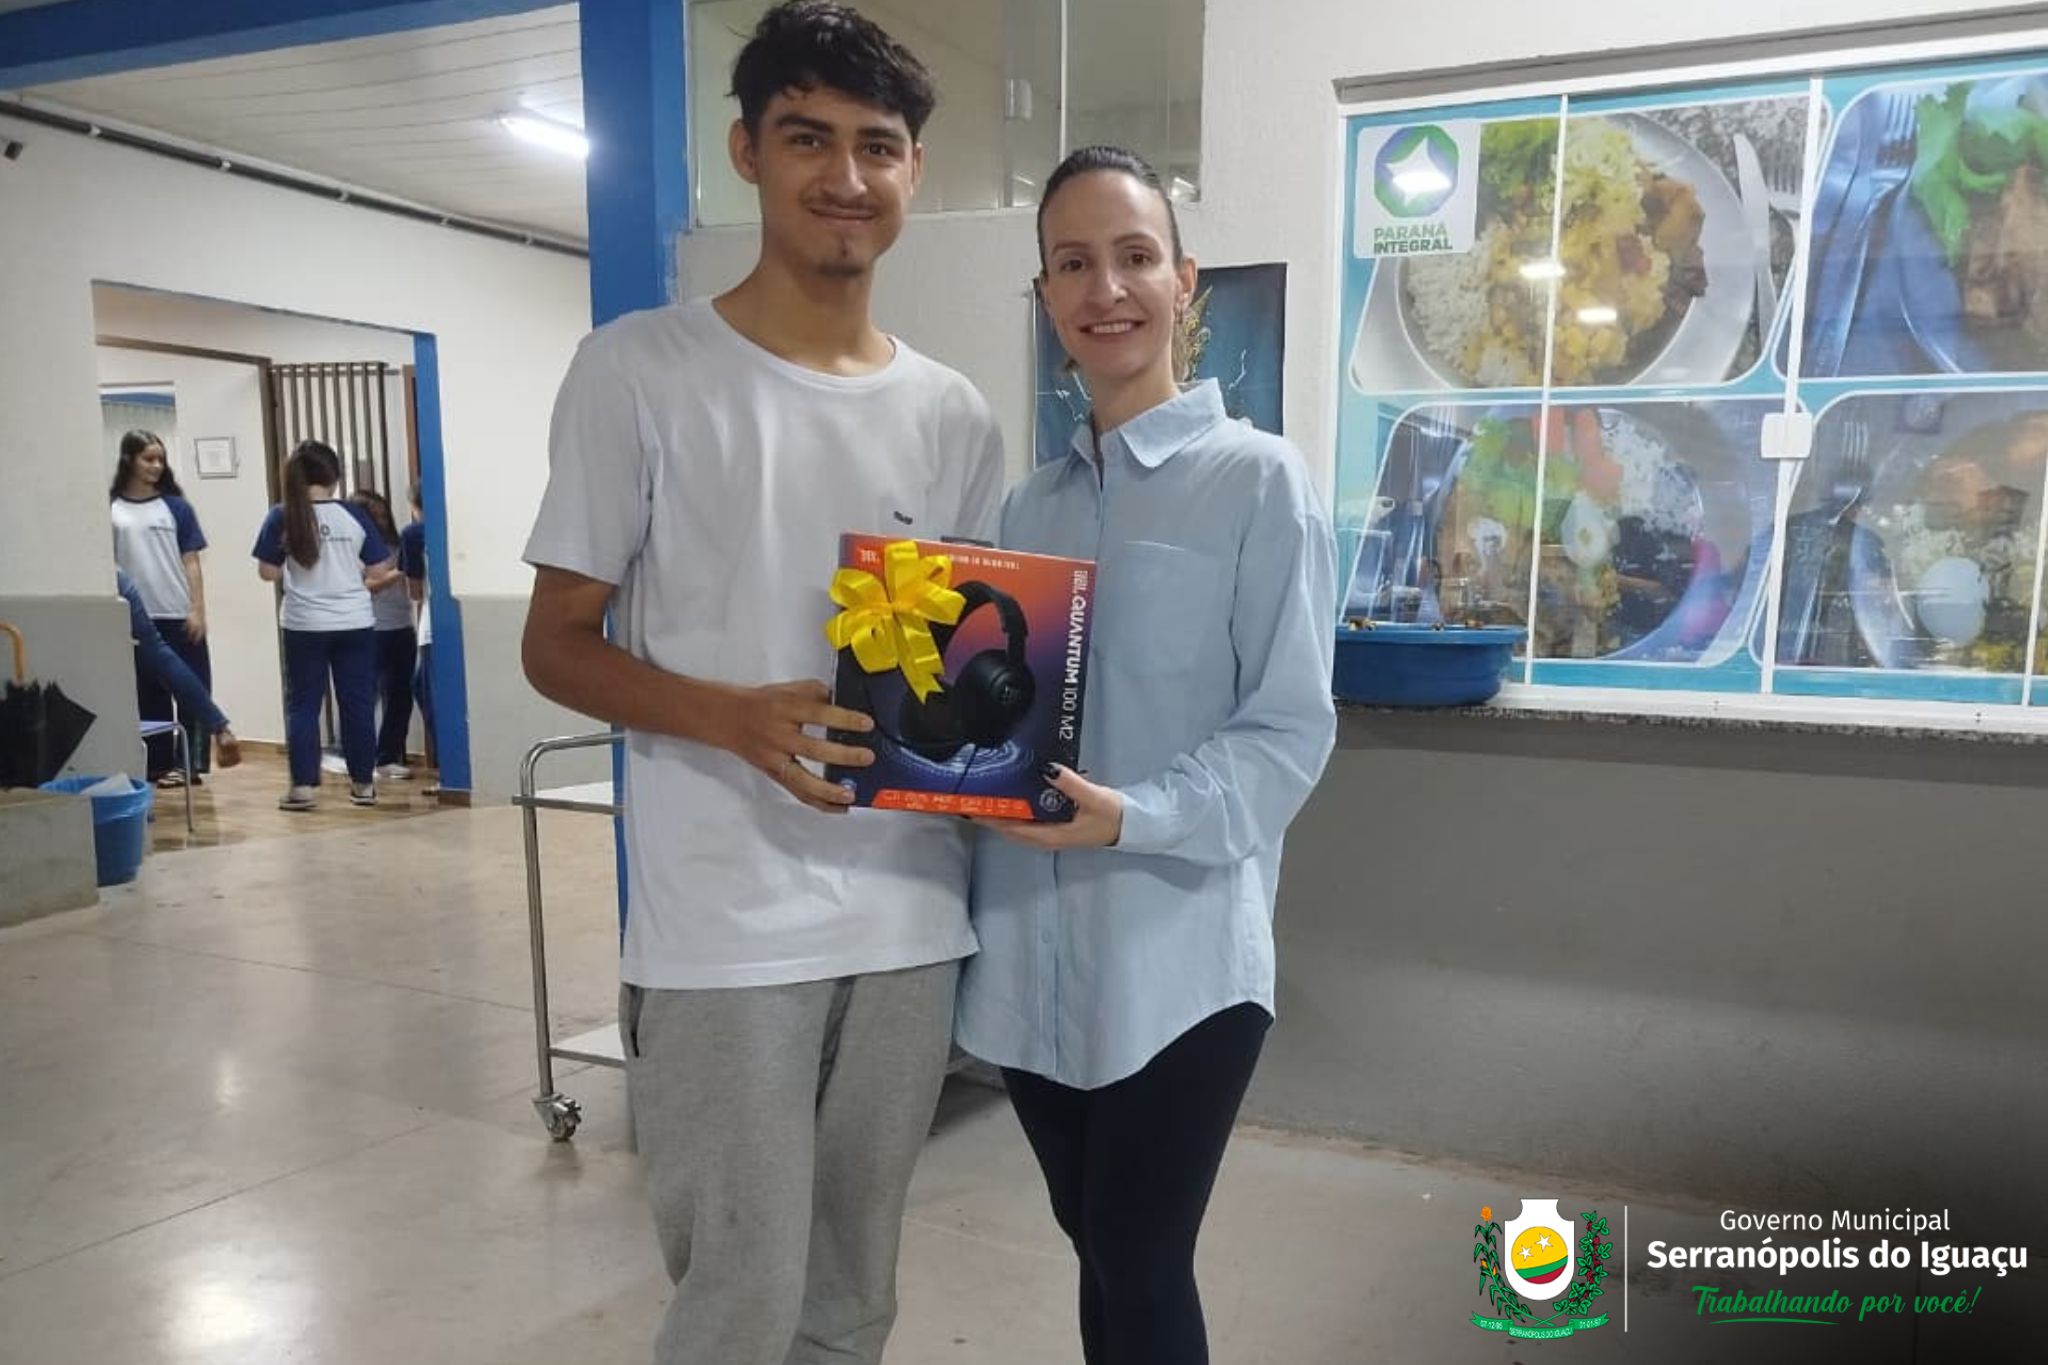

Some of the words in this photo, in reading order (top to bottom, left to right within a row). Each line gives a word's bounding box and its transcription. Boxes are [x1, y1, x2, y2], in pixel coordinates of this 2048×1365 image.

[1373, 238, 1453, 254] INTEGRAL
[1065, 595, 1087, 684] QUANTUM
[1062, 687, 1078, 712] 100
[1058, 715, 1075, 741] M2
